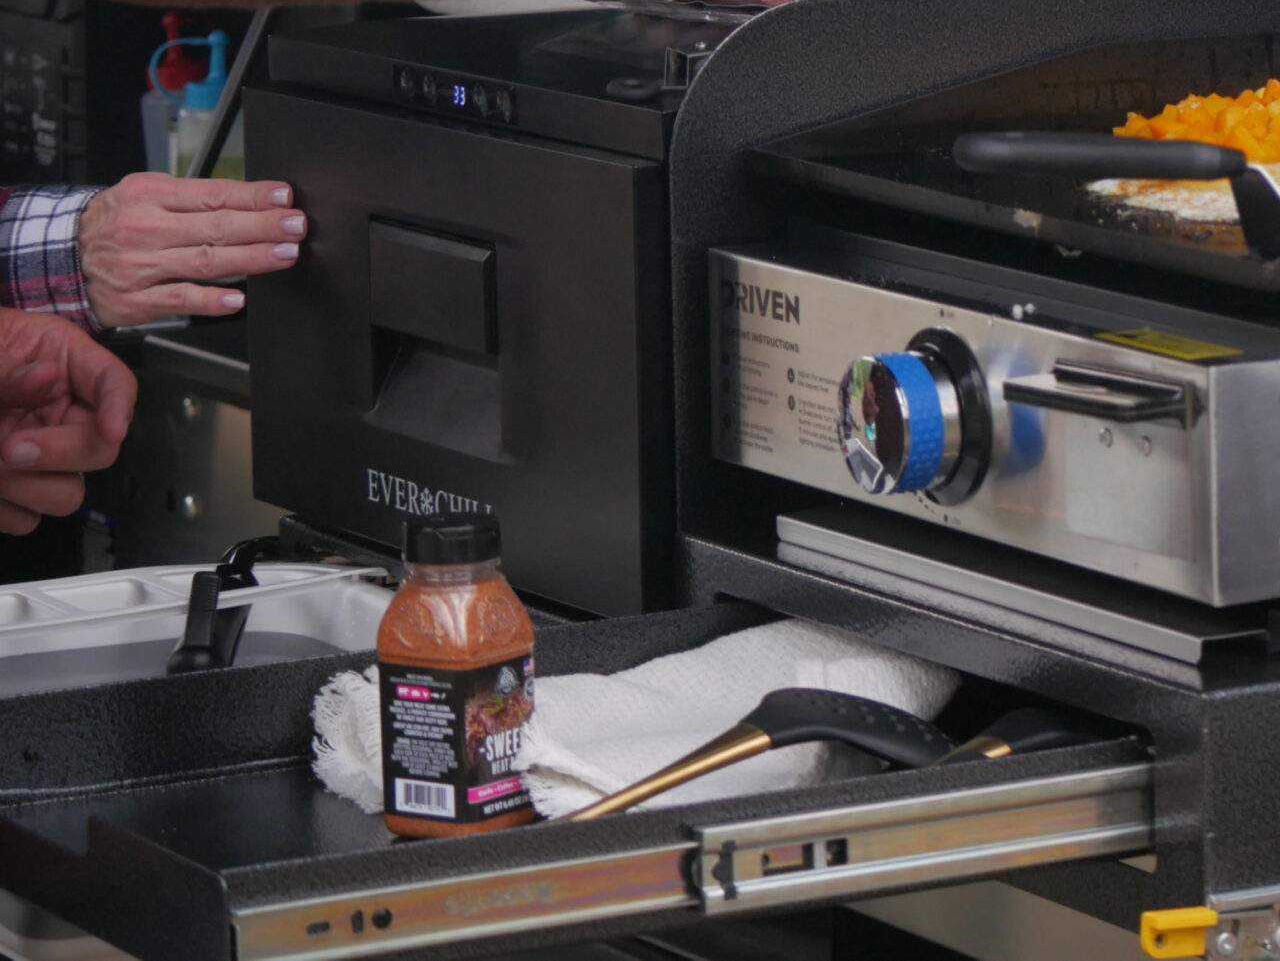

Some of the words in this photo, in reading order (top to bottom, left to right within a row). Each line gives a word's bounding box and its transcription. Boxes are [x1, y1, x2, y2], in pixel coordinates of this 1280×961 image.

[453, 85, 466, 106] 33
[721, 279, 800, 326] DRIVEN
[367, 468, 421, 516] EVER
[491, 757, 509, 776] HEAT
